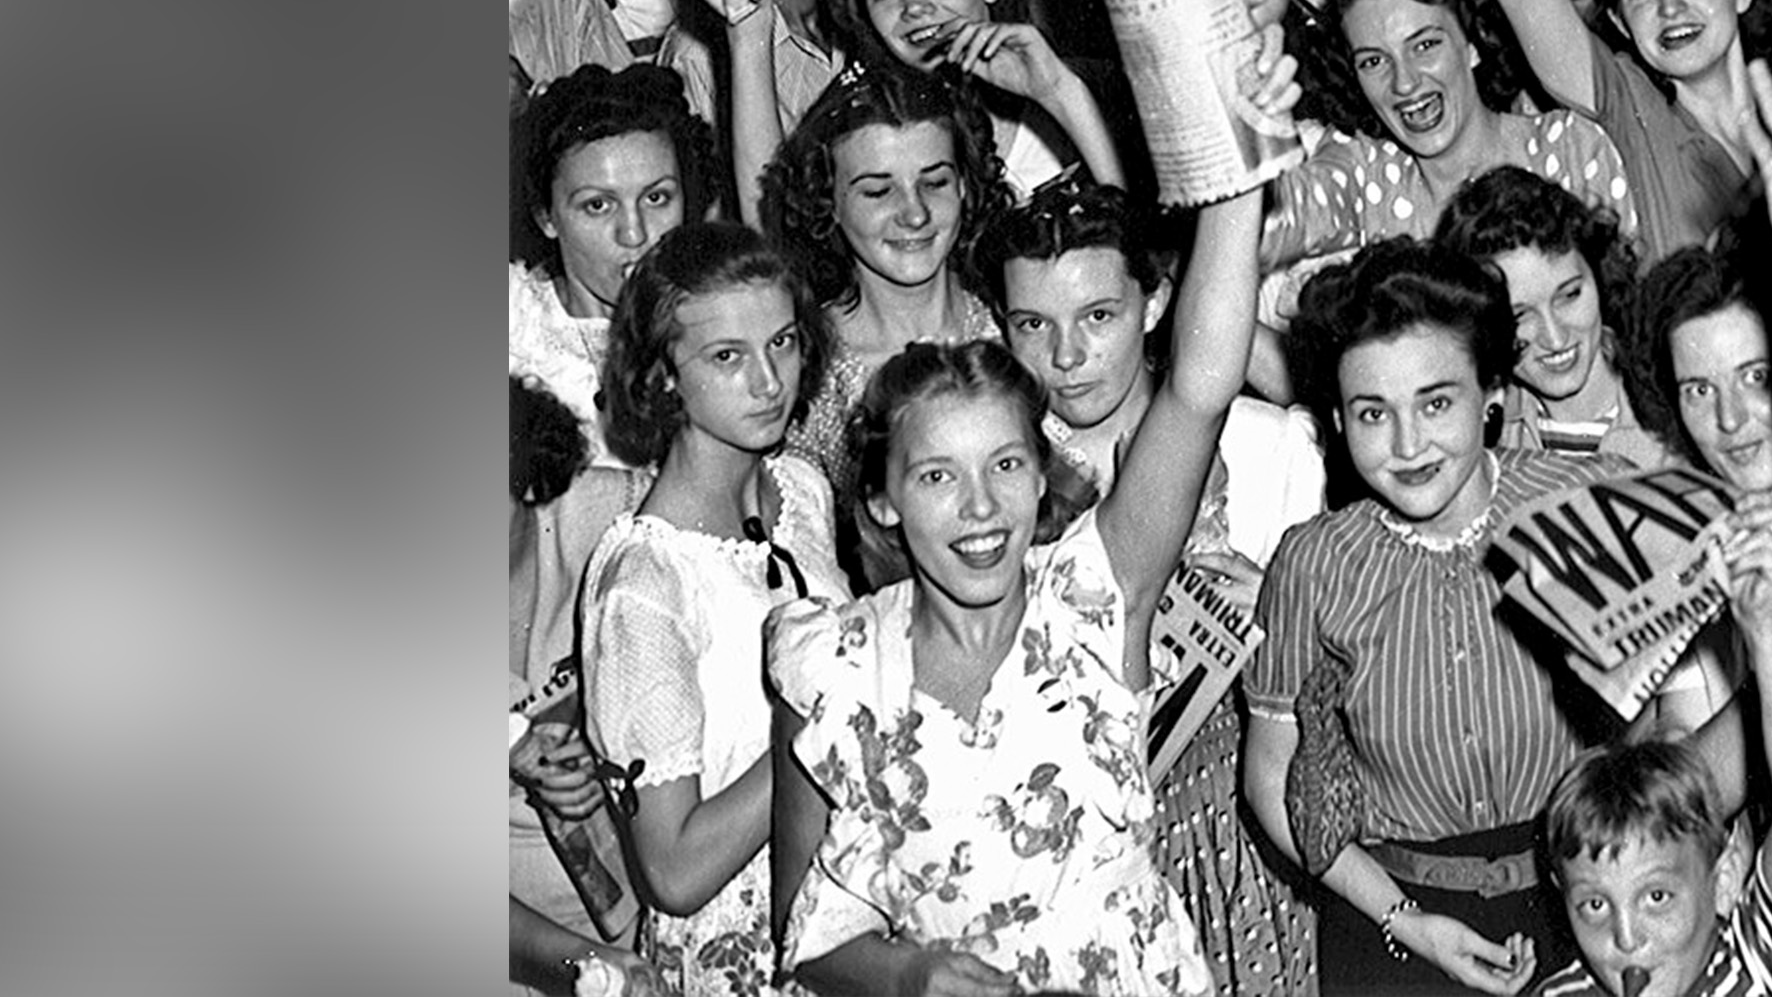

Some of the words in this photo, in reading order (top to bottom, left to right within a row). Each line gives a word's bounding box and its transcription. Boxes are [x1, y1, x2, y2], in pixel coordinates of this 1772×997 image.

[1508, 470, 1737, 611] WAR
[1176, 560, 1251, 647] TRUMAN
[1189, 618, 1237, 669] EXTRA
[1614, 577, 1731, 660] TRUMAN
